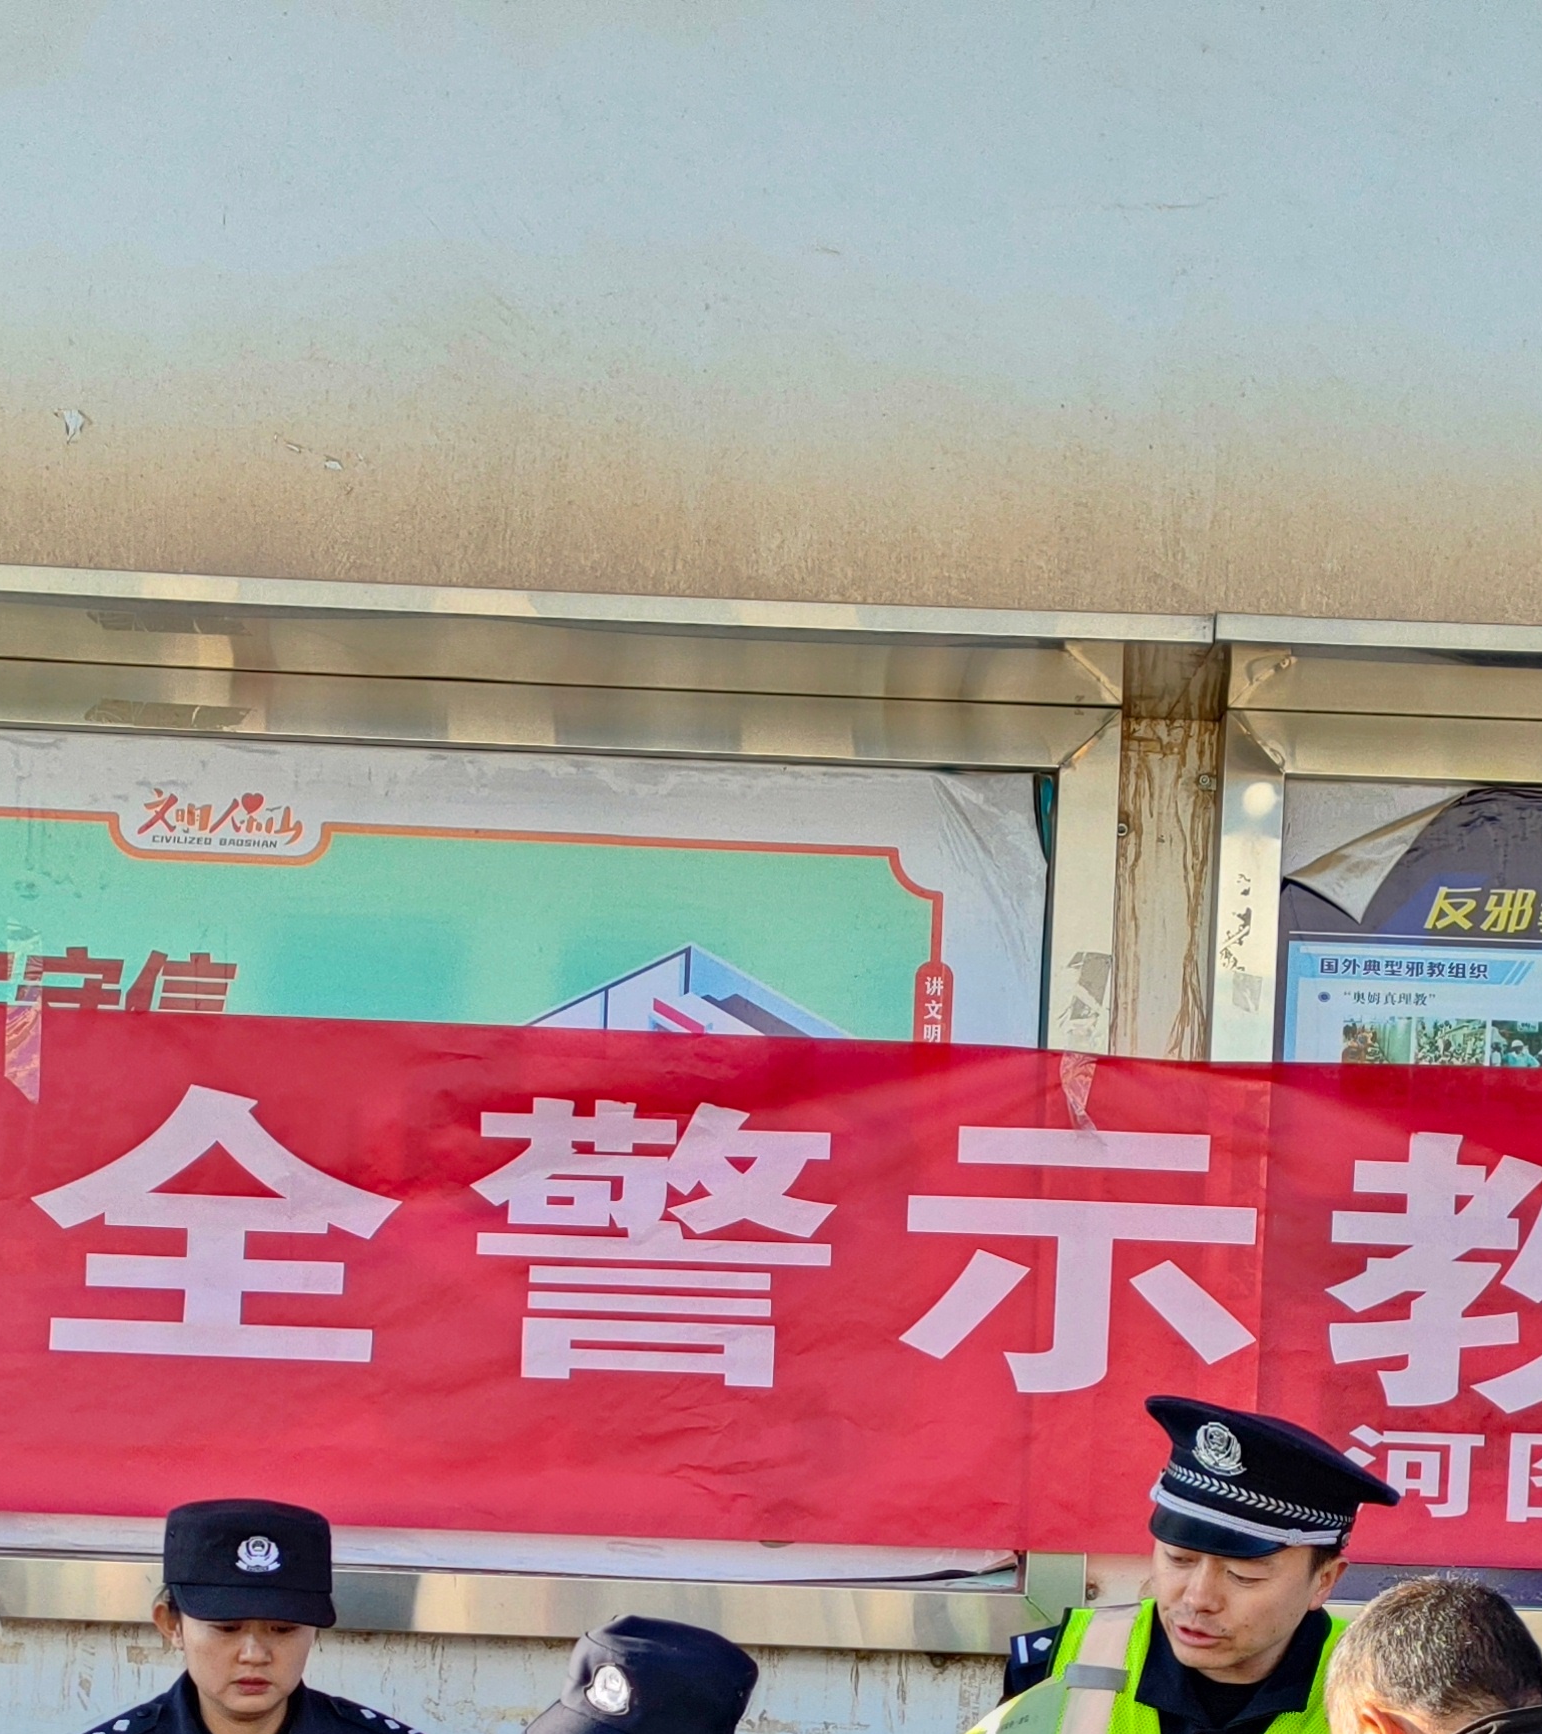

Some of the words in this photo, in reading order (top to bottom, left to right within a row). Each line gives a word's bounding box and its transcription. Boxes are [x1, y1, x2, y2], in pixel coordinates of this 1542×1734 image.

[151, 833, 212, 847] CIVILIZED
[218, 836, 278, 850] BAOSHAN
[1319, 956, 1490, 981] 国外典型邪教组织
